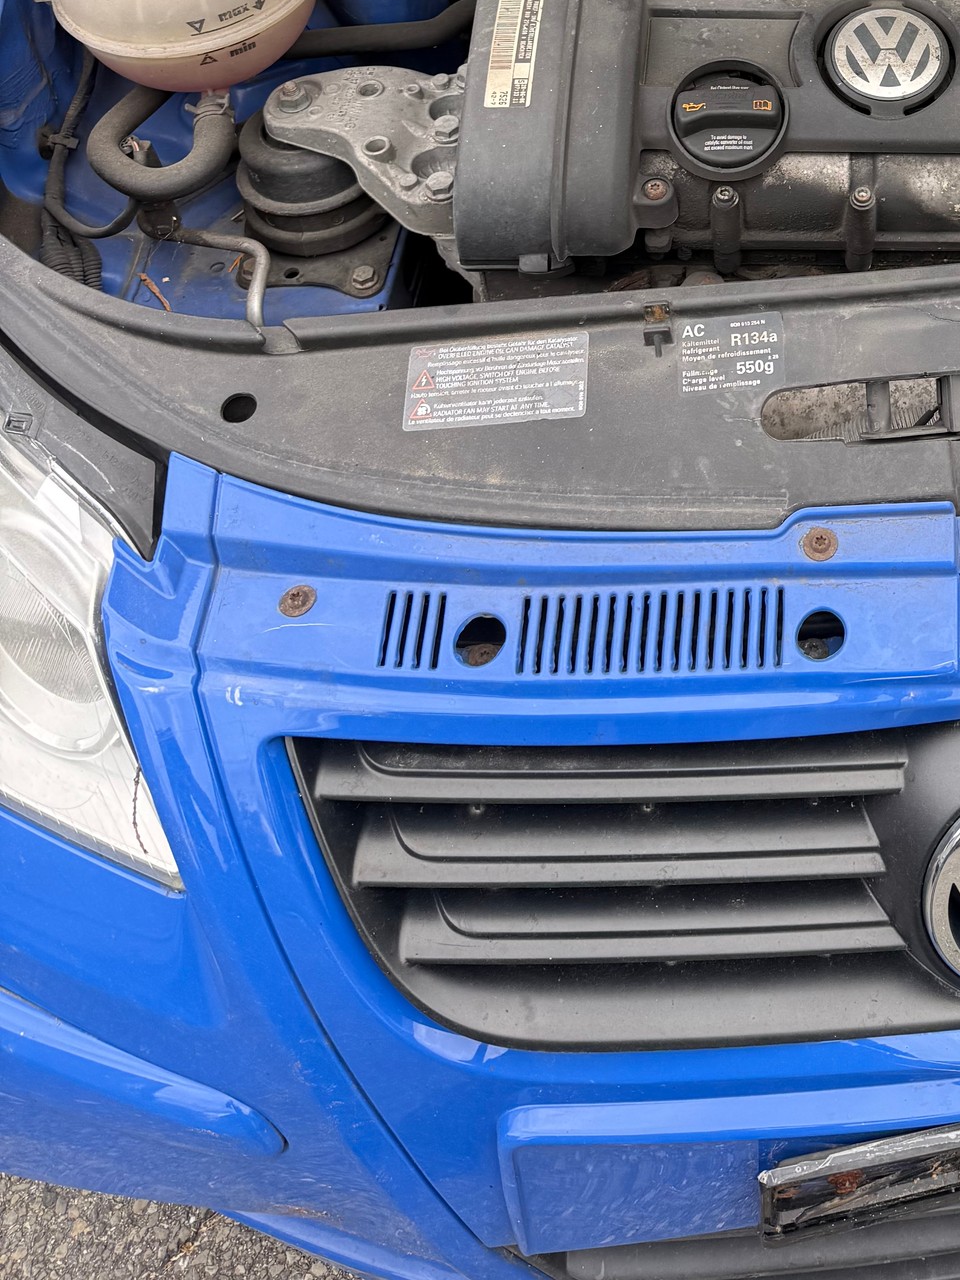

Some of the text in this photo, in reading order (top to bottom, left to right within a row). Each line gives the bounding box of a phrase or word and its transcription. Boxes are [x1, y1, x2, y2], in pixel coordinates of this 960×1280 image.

[218, 3, 250, 22] max
[230, 41, 256, 57] min
[835, 7, 944, 101] VW
[682, 324, 705, 338] AC
[682, 339, 720, 347] Kältemittel
[731, 331, 777, 346] R134a
[682, 346, 720, 355] Refrigerant
[718, 348, 771, 358] refroidissement
[736, 360, 774, 375] 550g
[435, 381, 467, 389] TOUCHING
[719, 379, 761, 388] remplissage
[433, 409, 462, 417] RADIATOR
